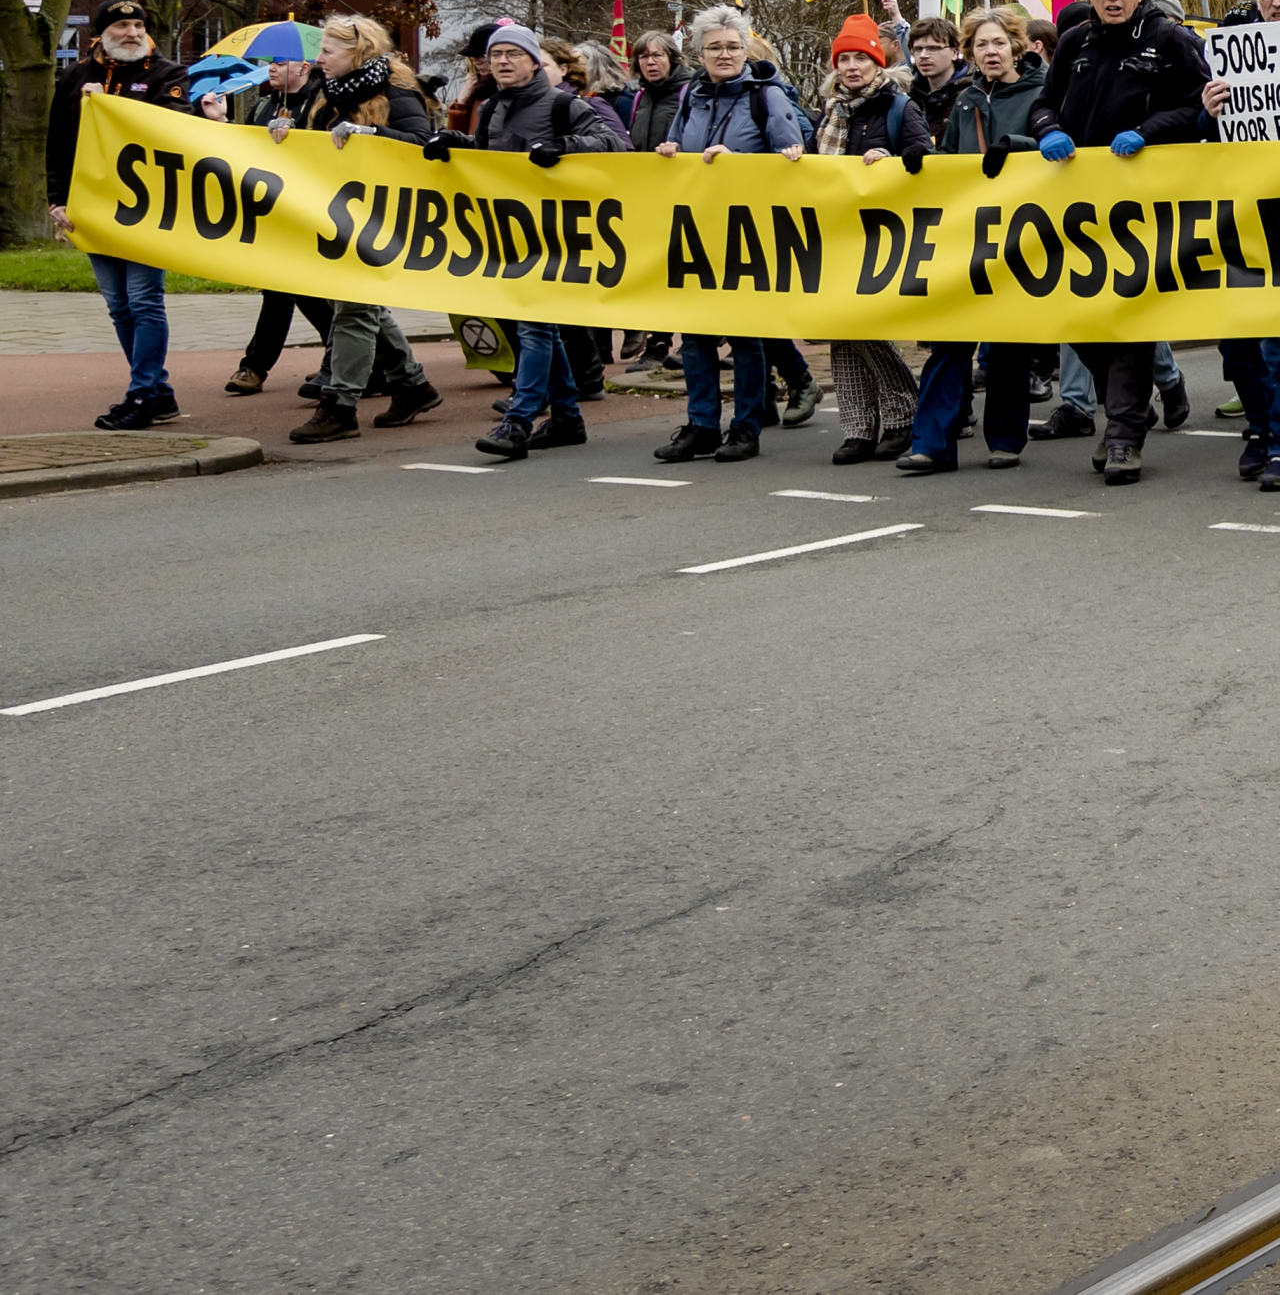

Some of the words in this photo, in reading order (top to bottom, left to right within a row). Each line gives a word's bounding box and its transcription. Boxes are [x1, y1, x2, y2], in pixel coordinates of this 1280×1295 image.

[1222, 117, 1270, 142] VOOR
[115, 143, 284, 245] STOP
[317, 181, 623, 288] SUBSIDIES
[668, 204, 822, 294] AAN
[857, 208, 943, 296] DE
